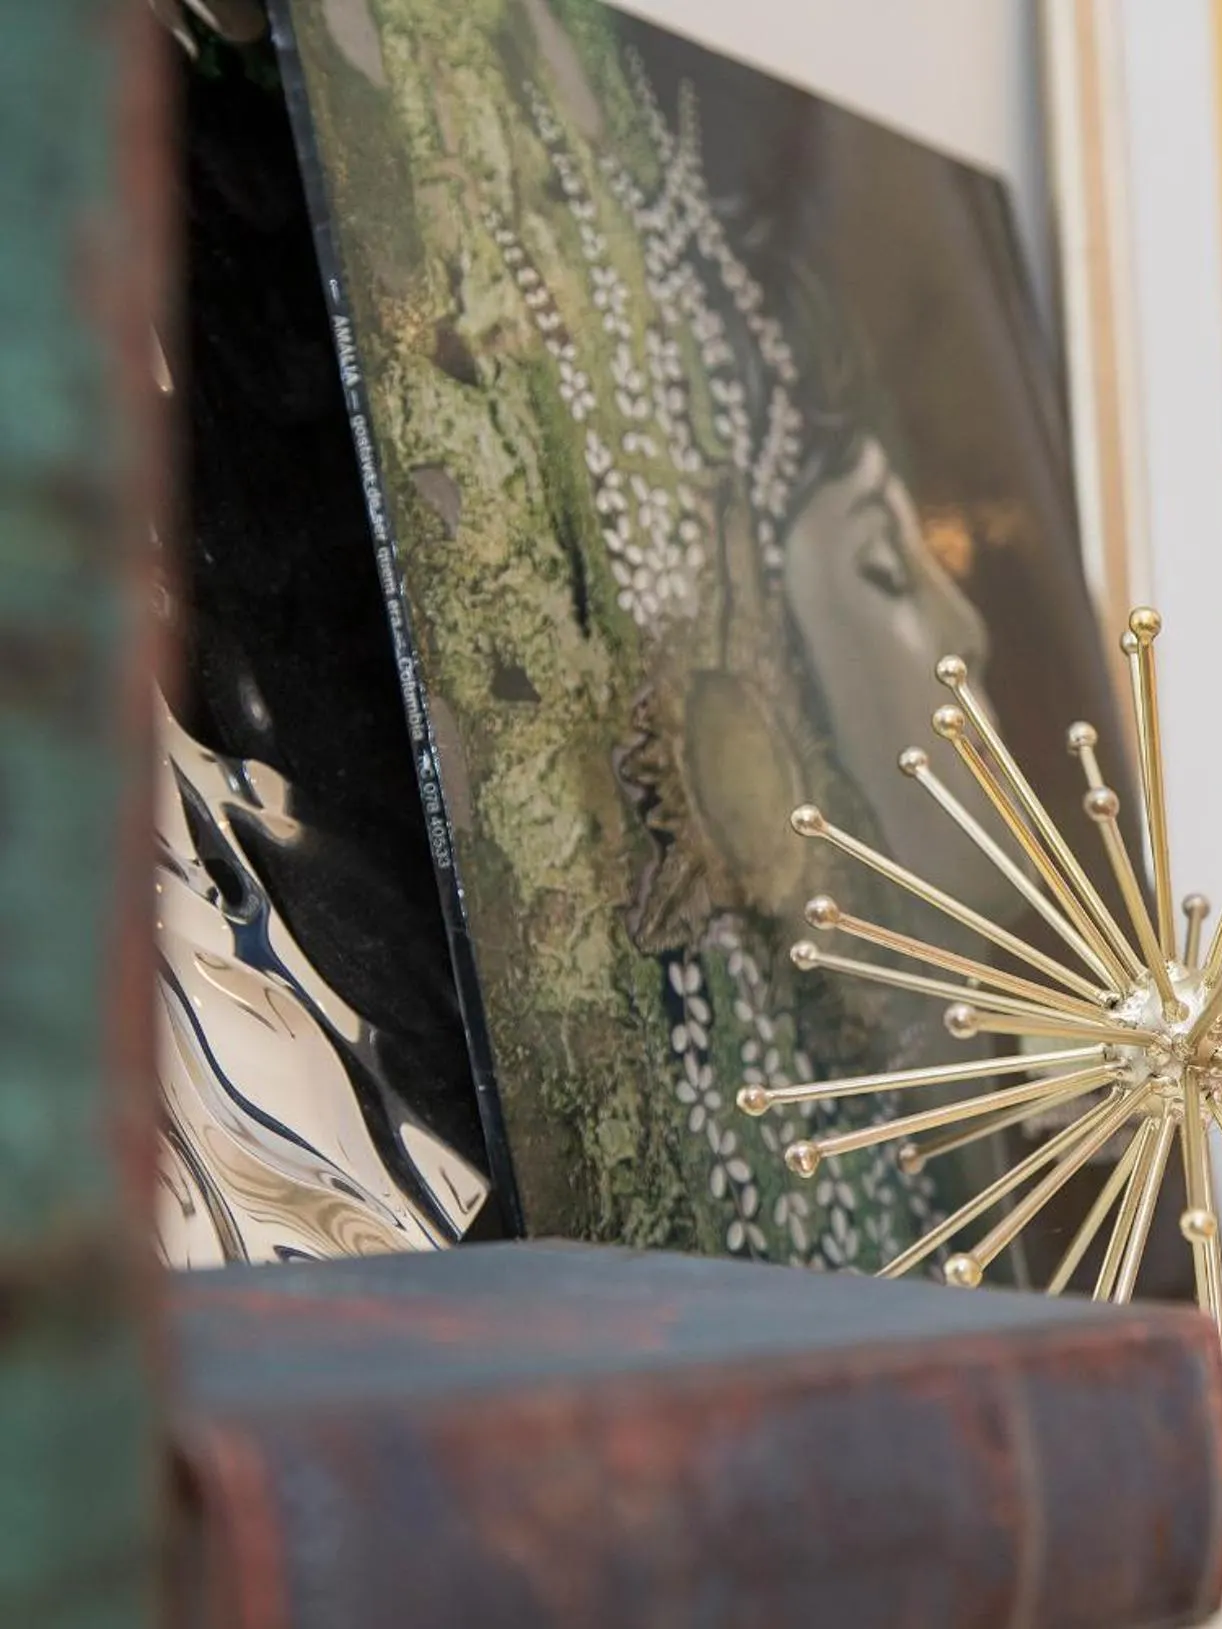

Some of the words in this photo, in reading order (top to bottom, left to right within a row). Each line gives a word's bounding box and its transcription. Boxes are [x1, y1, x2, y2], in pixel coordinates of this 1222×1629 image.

[372, 513, 388, 541] ser
[376, 546, 396, 596] quem
[387, 599, 404, 628] era
[399, 656, 424, 741] Columbia
